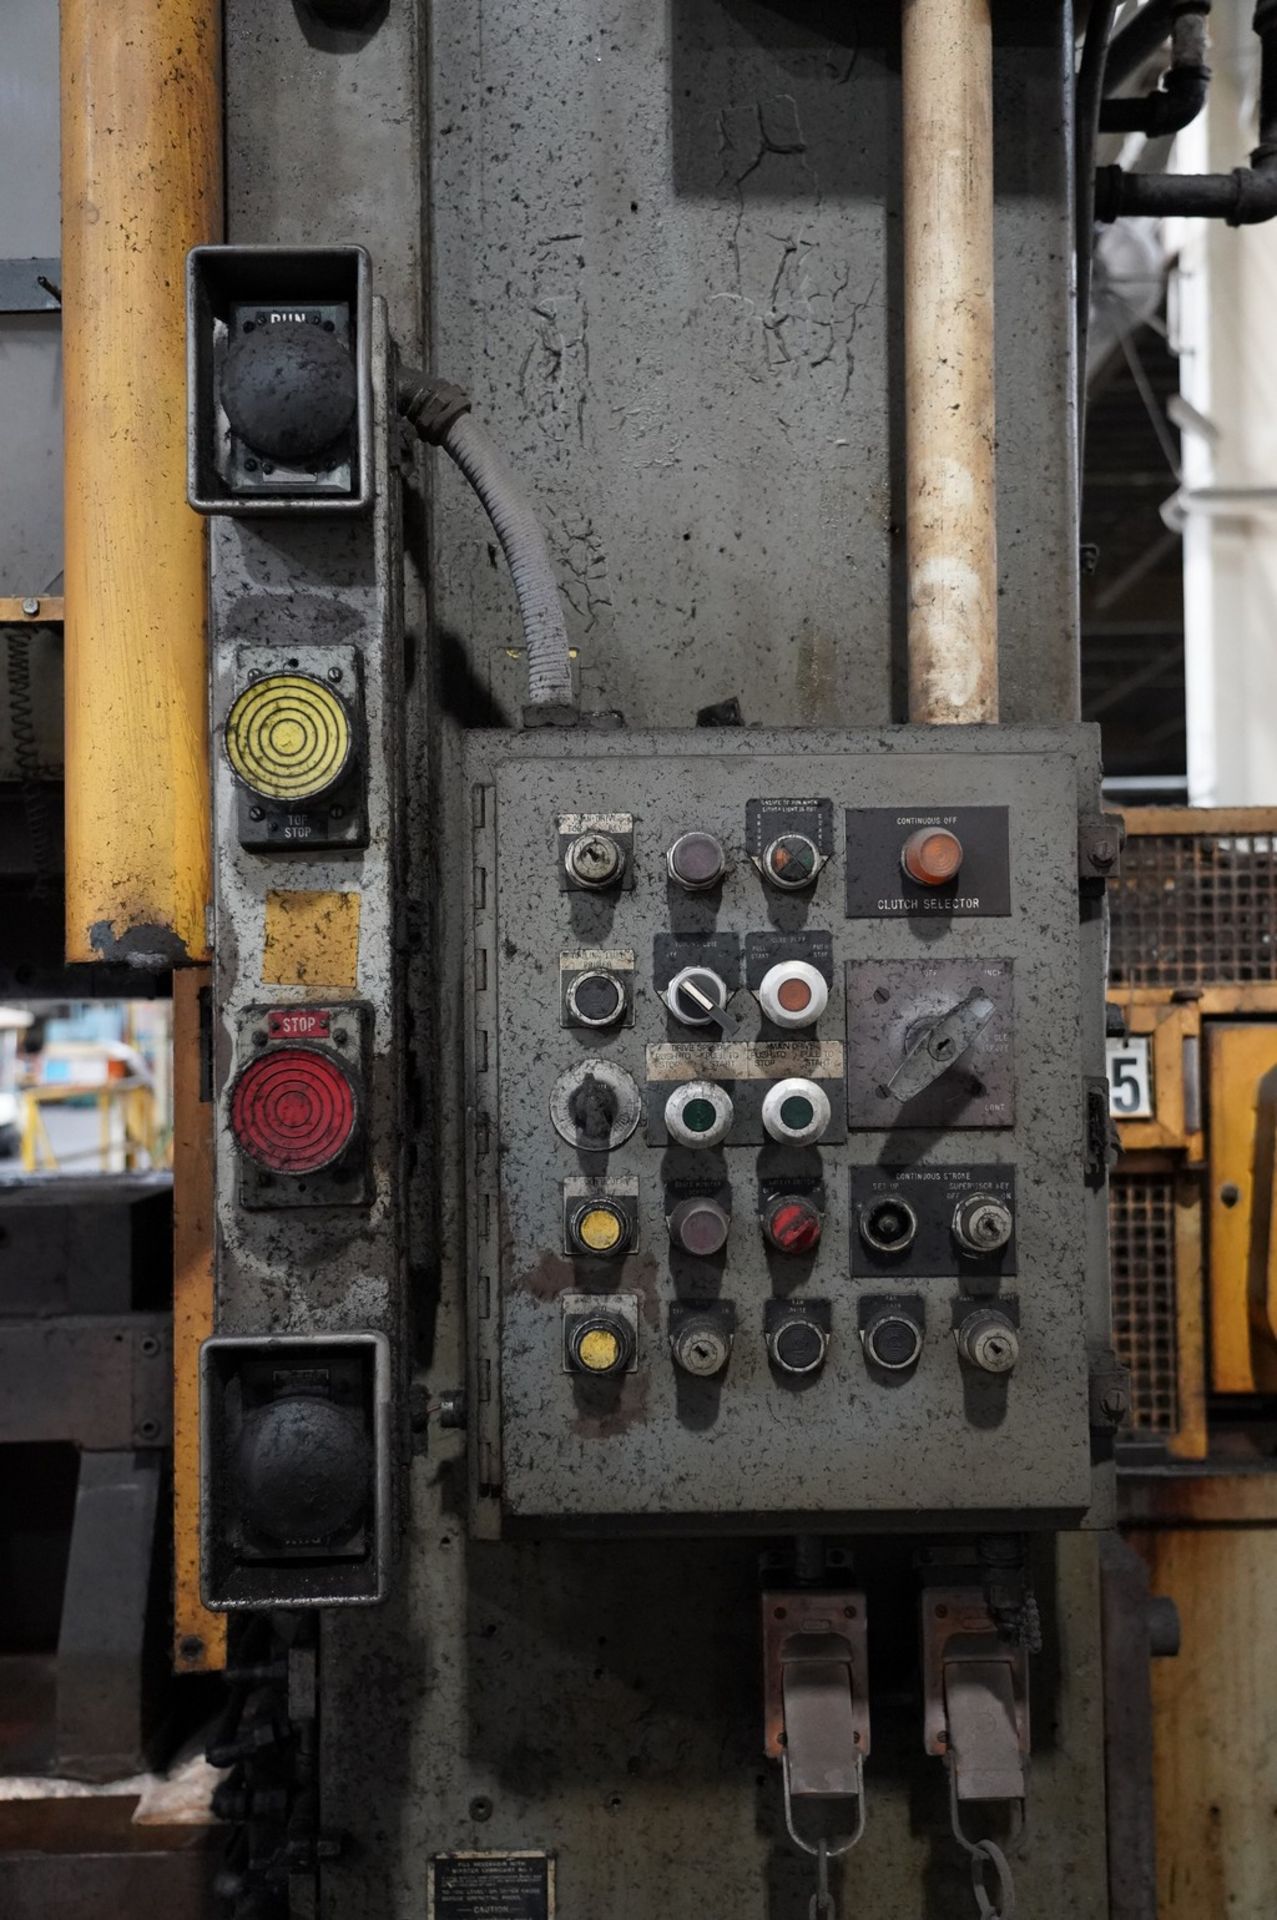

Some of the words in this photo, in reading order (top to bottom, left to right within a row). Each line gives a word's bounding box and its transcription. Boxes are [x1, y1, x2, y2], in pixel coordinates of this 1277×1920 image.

[896, 817, 941, 825] CONTINUOUS
[943, 817, 958, 825] OFF
[284, 827, 312, 839] STOP
[877, 899, 919, 911] CLUTCH
[923, 898, 980, 910] SELECTOR
[282, 1017, 316, 1032] STOP
[672, 1044, 694, 1052] DRIVE
[754, 1059, 776, 1067] STOP
[1112, 1058, 1141, 1113] 5
[896, 1172, 941, 1181] CONTINUOUS
[943, 1172, 972, 1180] STROKE
[872, 1182, 886, 1190] SET
[948, 1182, 993, 1190] SUPERVISOR
[473, 1905, 510, 1914] CAUTION
